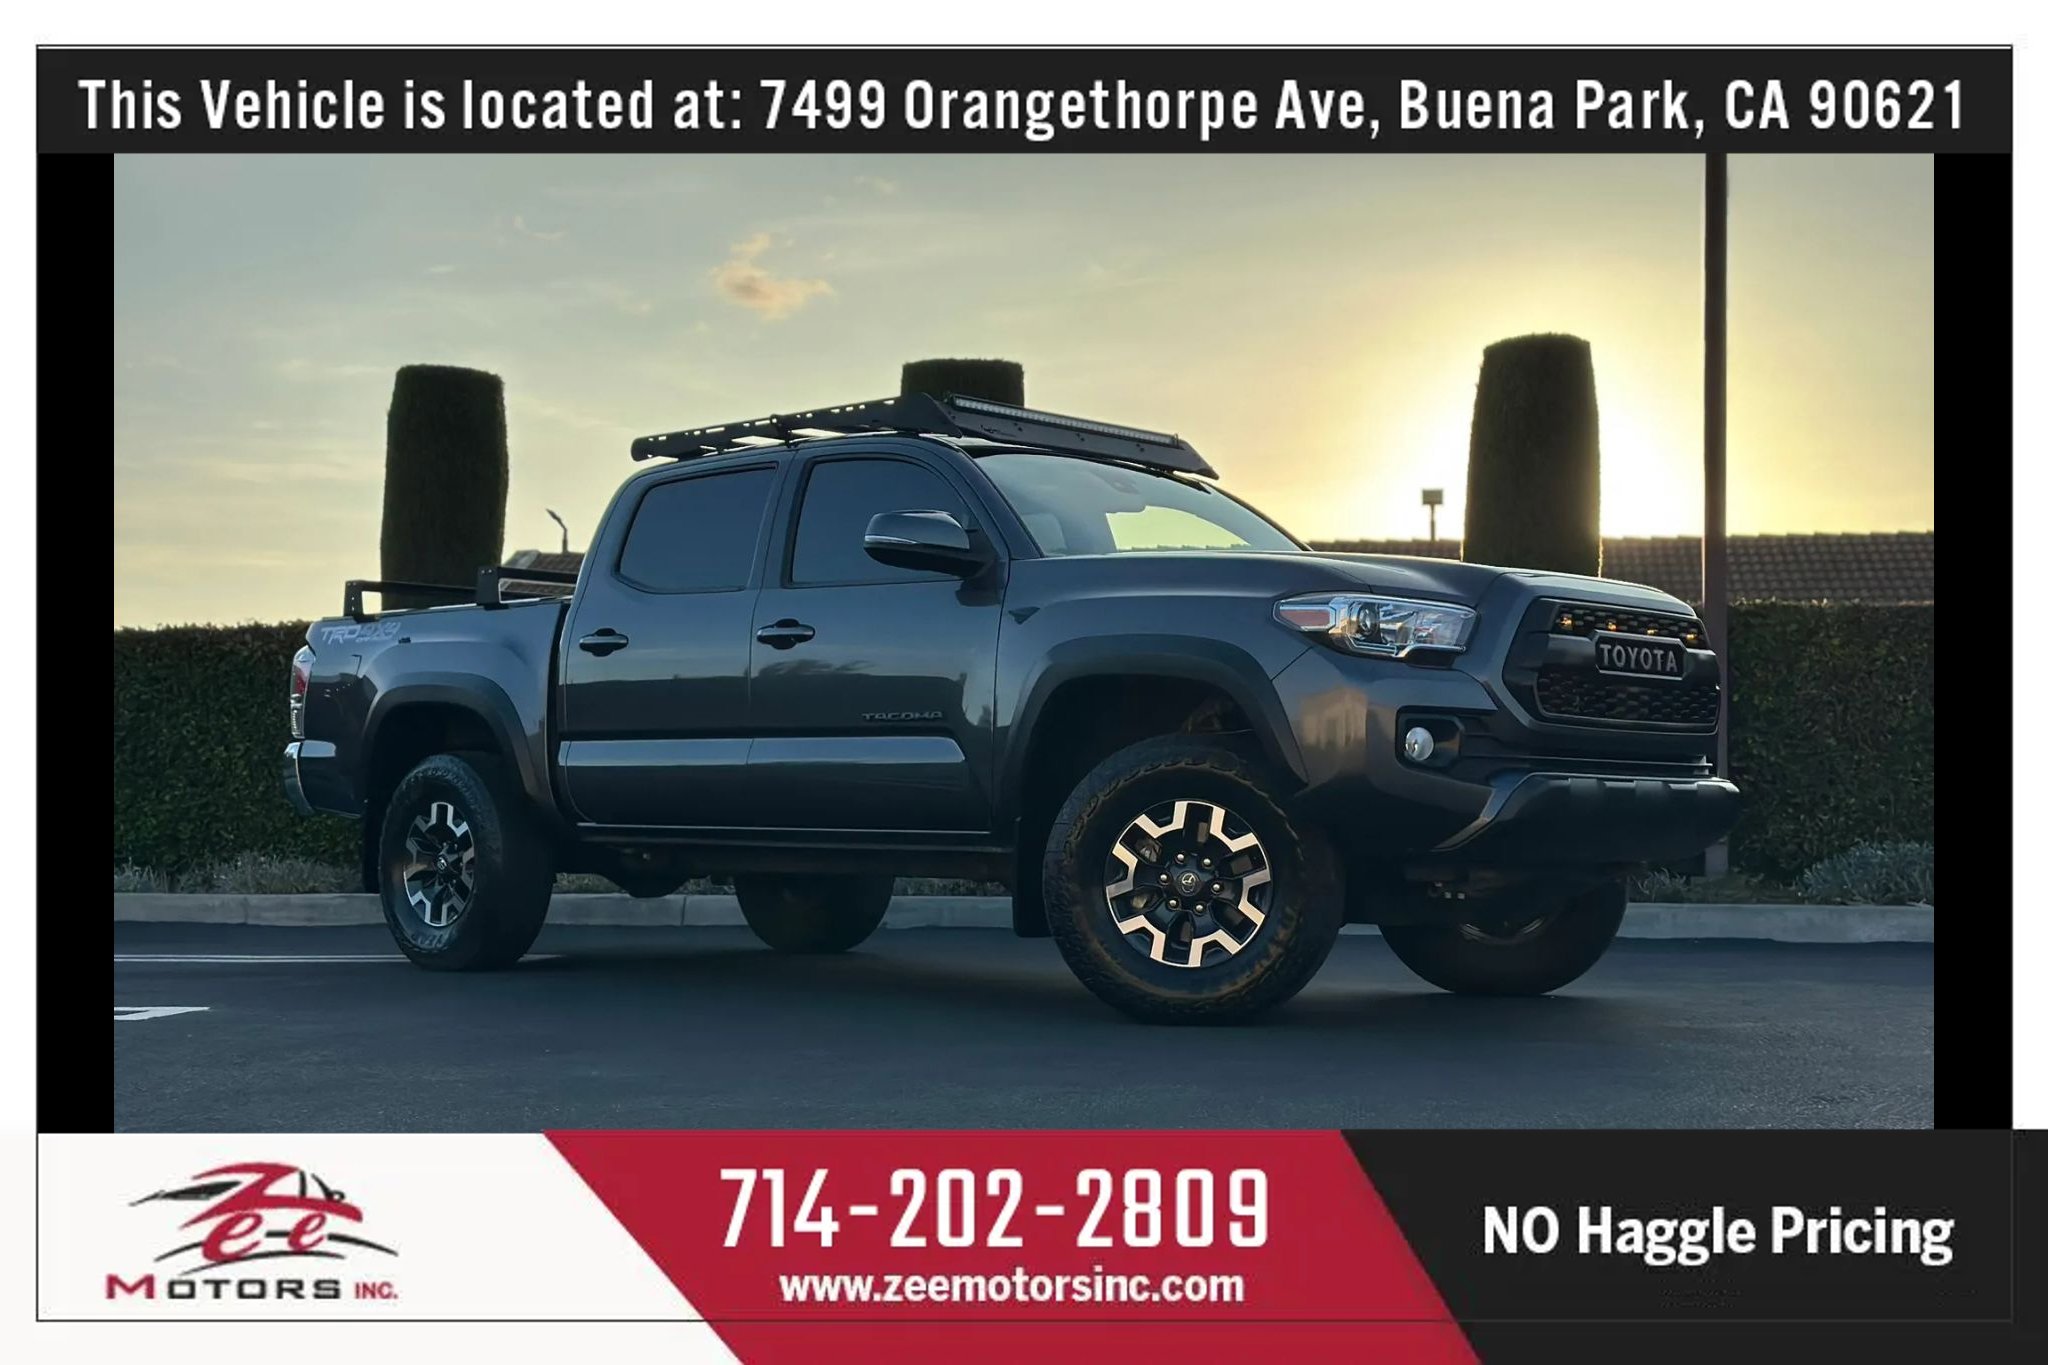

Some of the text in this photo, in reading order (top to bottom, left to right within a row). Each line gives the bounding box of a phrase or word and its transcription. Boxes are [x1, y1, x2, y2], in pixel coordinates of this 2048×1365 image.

[321, 625, 361, 644] TRD
[1599, 643, 1678, 673] TOYOTA
[862, 711, 943, 720] TACOMA
